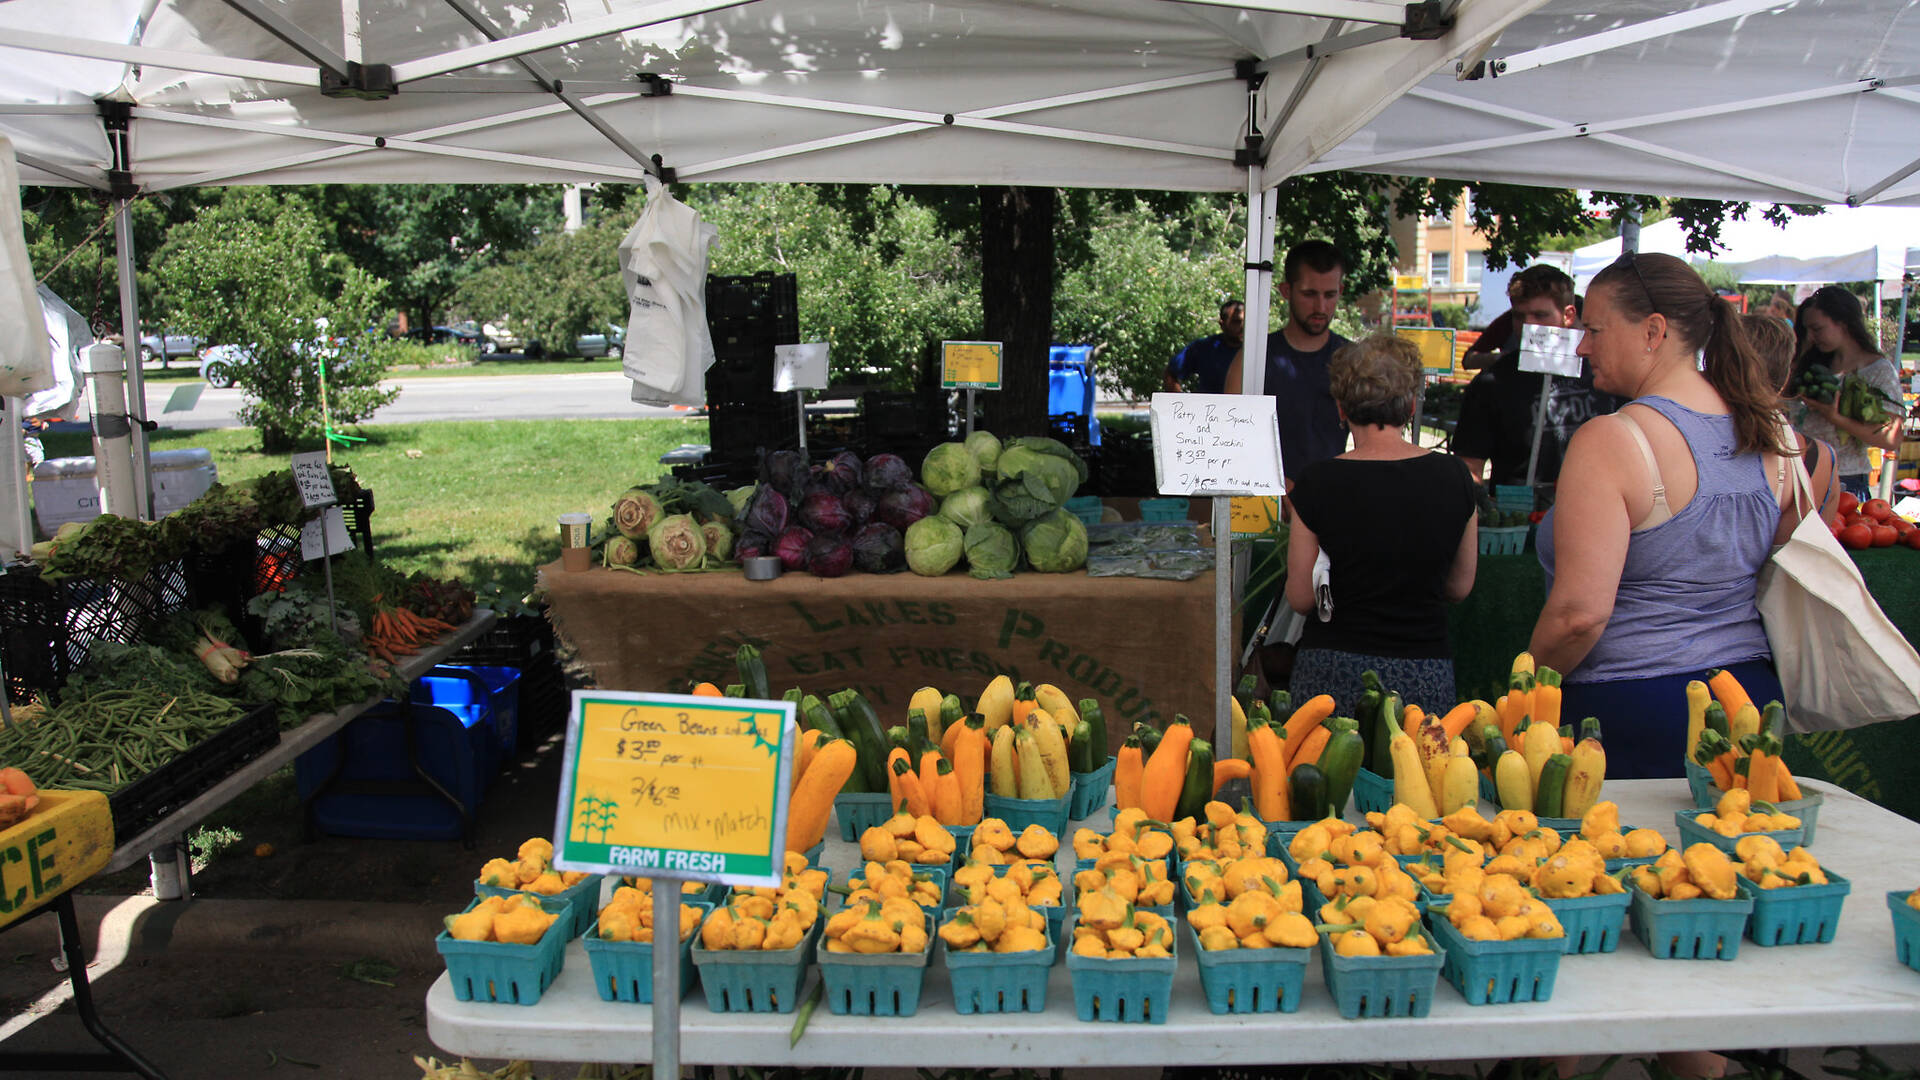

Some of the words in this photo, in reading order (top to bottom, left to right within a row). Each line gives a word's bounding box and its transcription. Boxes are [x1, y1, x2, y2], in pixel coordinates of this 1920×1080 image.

[1172, 401, 1195, 424] Patty
[1205, 404, 1219, 422] Pan
[1176, 432, 1204, 445] Small
[1197, 423, 1211, 433] and
[1208, 458, 1219, 469] per
[788, 600, 957, 633] LAKES
[788, 646, 865, 675] EAT
[620, 708, 667, 732] Green
[678, 711, 718, 735] Beans
[661, 753, 684, 768] per
[609, 846, 660, 868] FARM
[664, 851, 726, 873] FRESH
